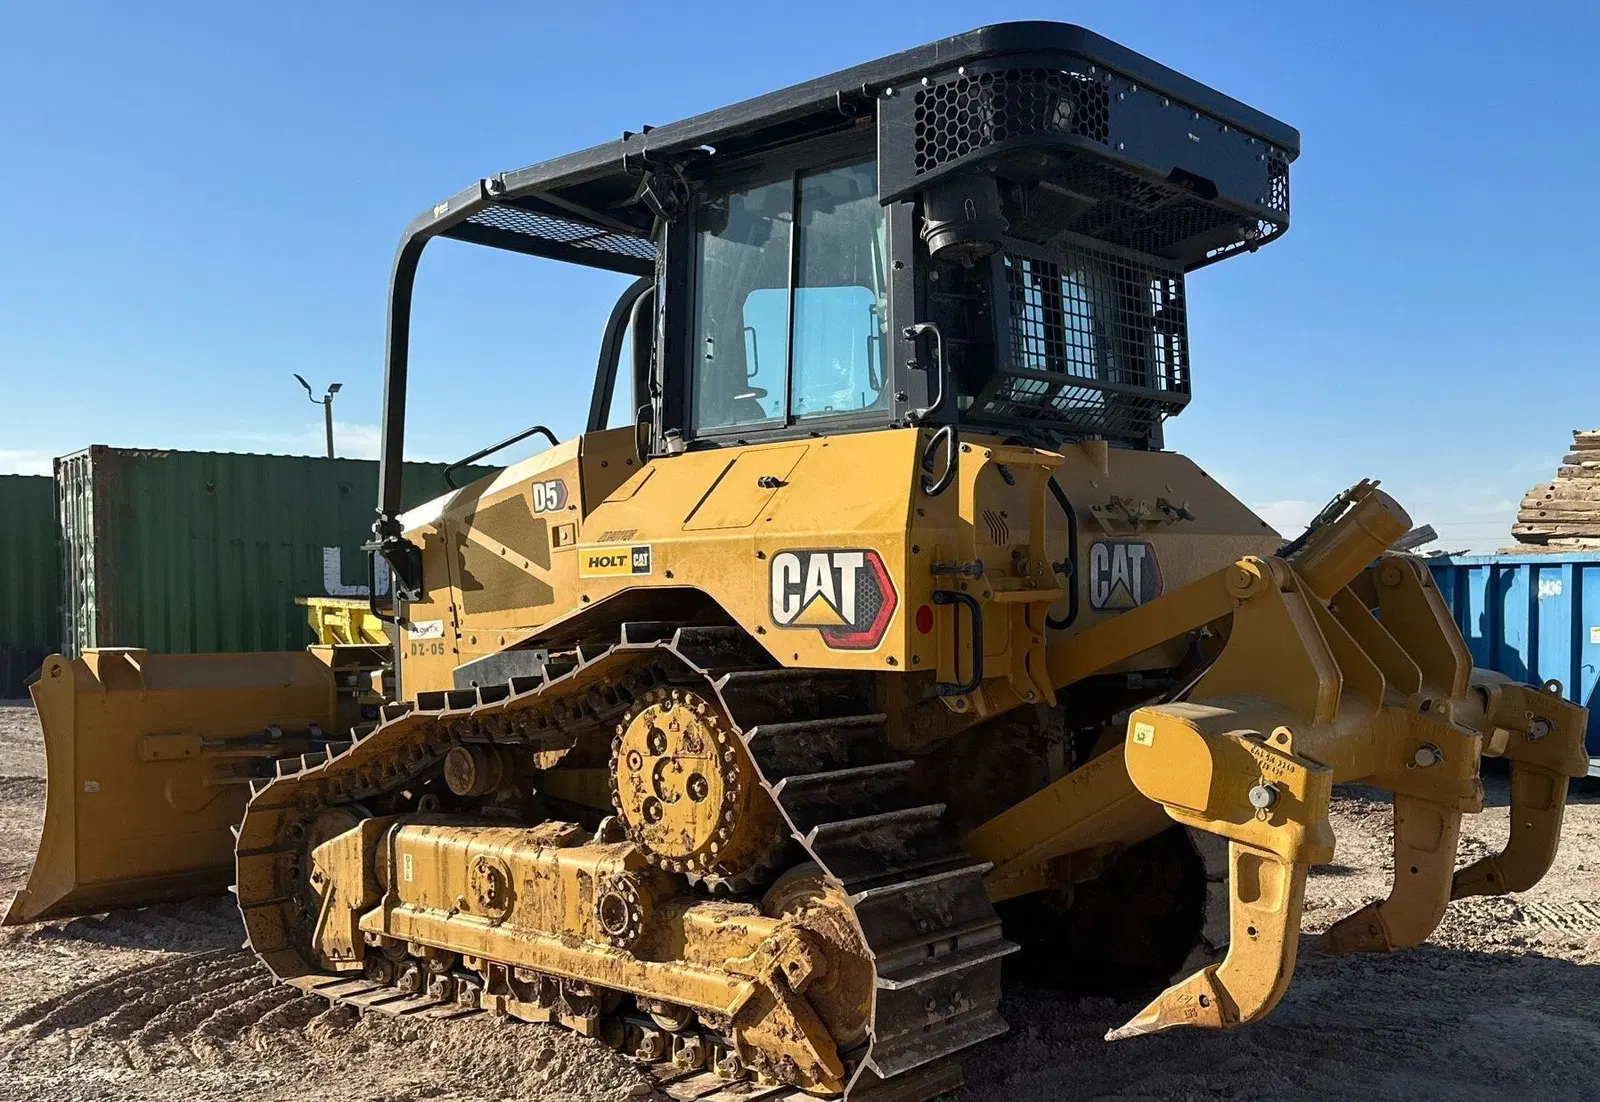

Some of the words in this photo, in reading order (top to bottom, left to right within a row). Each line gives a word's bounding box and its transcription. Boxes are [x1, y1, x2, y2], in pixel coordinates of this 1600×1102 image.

[533, 481, 558, 512] D5
[589, 555, 627, 568] HOLT
[633, 553, 649, 567] CAT
[1090, 543, 1146, 608] CAT
[772, 552, 864, 625] CAT
